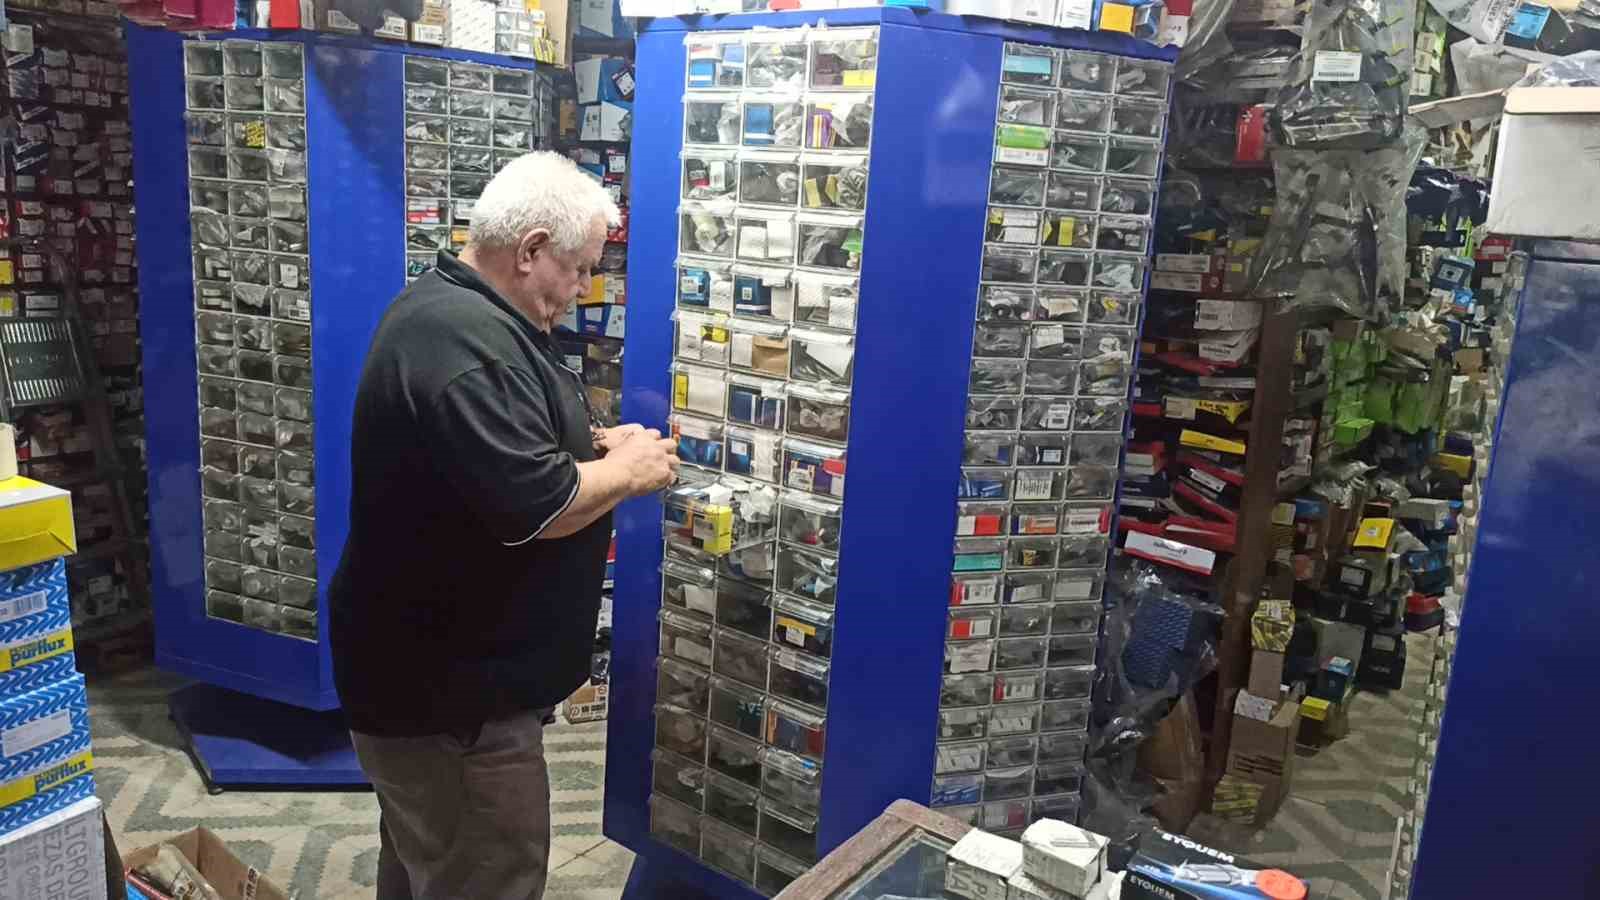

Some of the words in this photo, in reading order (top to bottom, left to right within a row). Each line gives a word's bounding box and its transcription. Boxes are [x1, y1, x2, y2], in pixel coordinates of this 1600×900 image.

[10, 638, 65, 667] purflux
[36, 760, 86, 792] purflux
[64, 817, 89, 900] LTGROU
[1161, 833, 1235, 863] EYQUEM
[1130, 875, 1176, 900] EYQUEM
